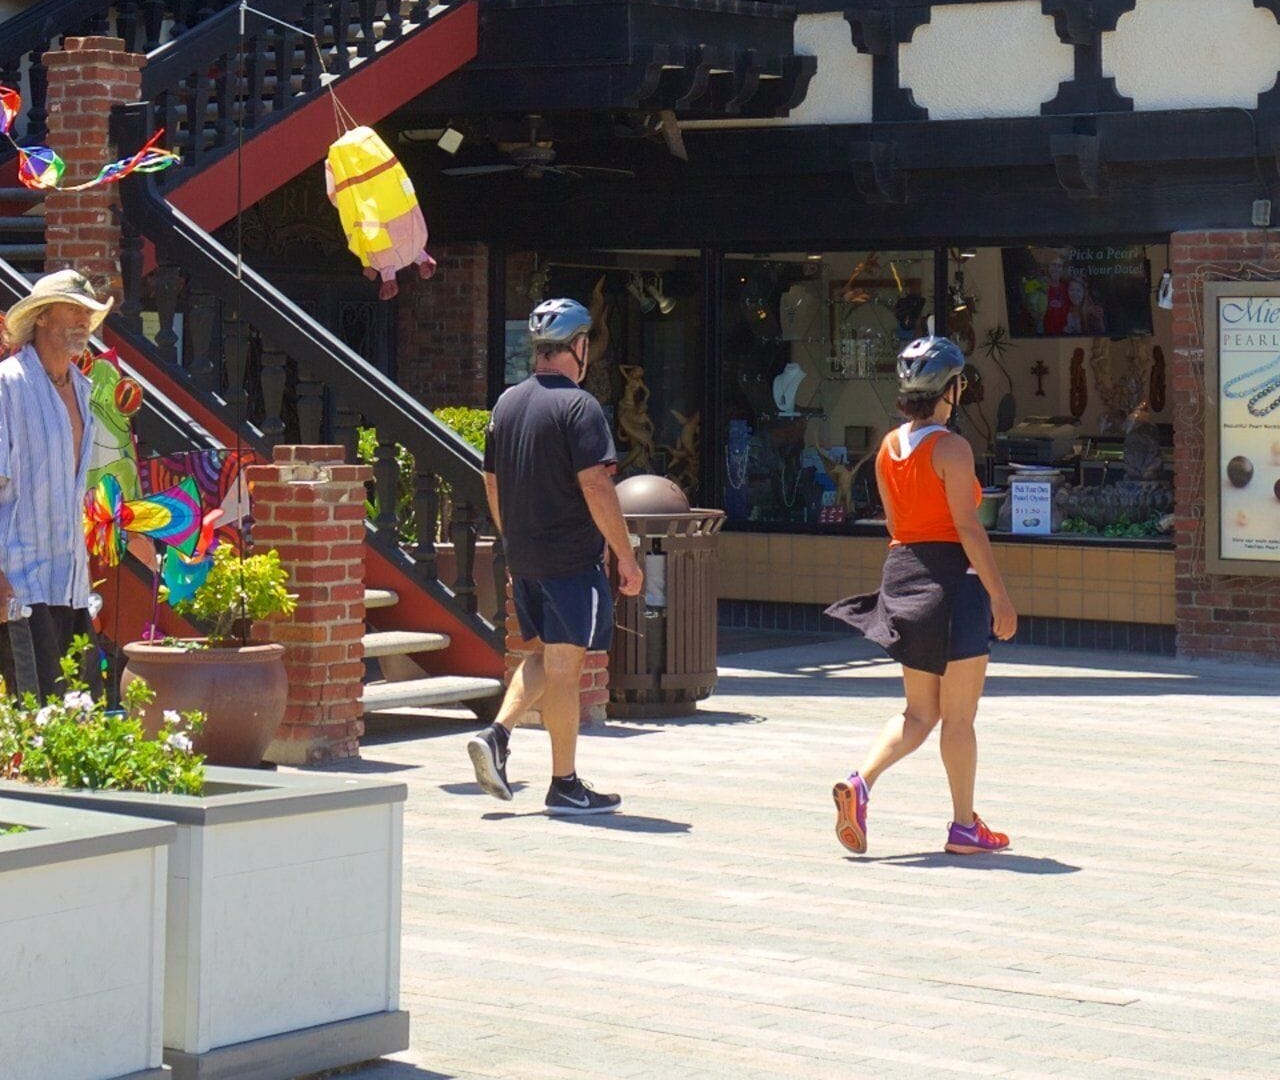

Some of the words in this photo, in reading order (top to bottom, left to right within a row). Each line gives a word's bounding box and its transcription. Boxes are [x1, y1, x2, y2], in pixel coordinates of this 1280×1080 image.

[1068, 247, 1093, 261] Pick
[1096, 251, 1103, 260] a
[1106, 246, 1139, 260] Pearl
[1068, 265, 1084, 276] For
[1087, 264, 1112, 276] Your
[1222, 297, 1280, 323] Mie
[1224, 334, 1279, 346] PEARL
